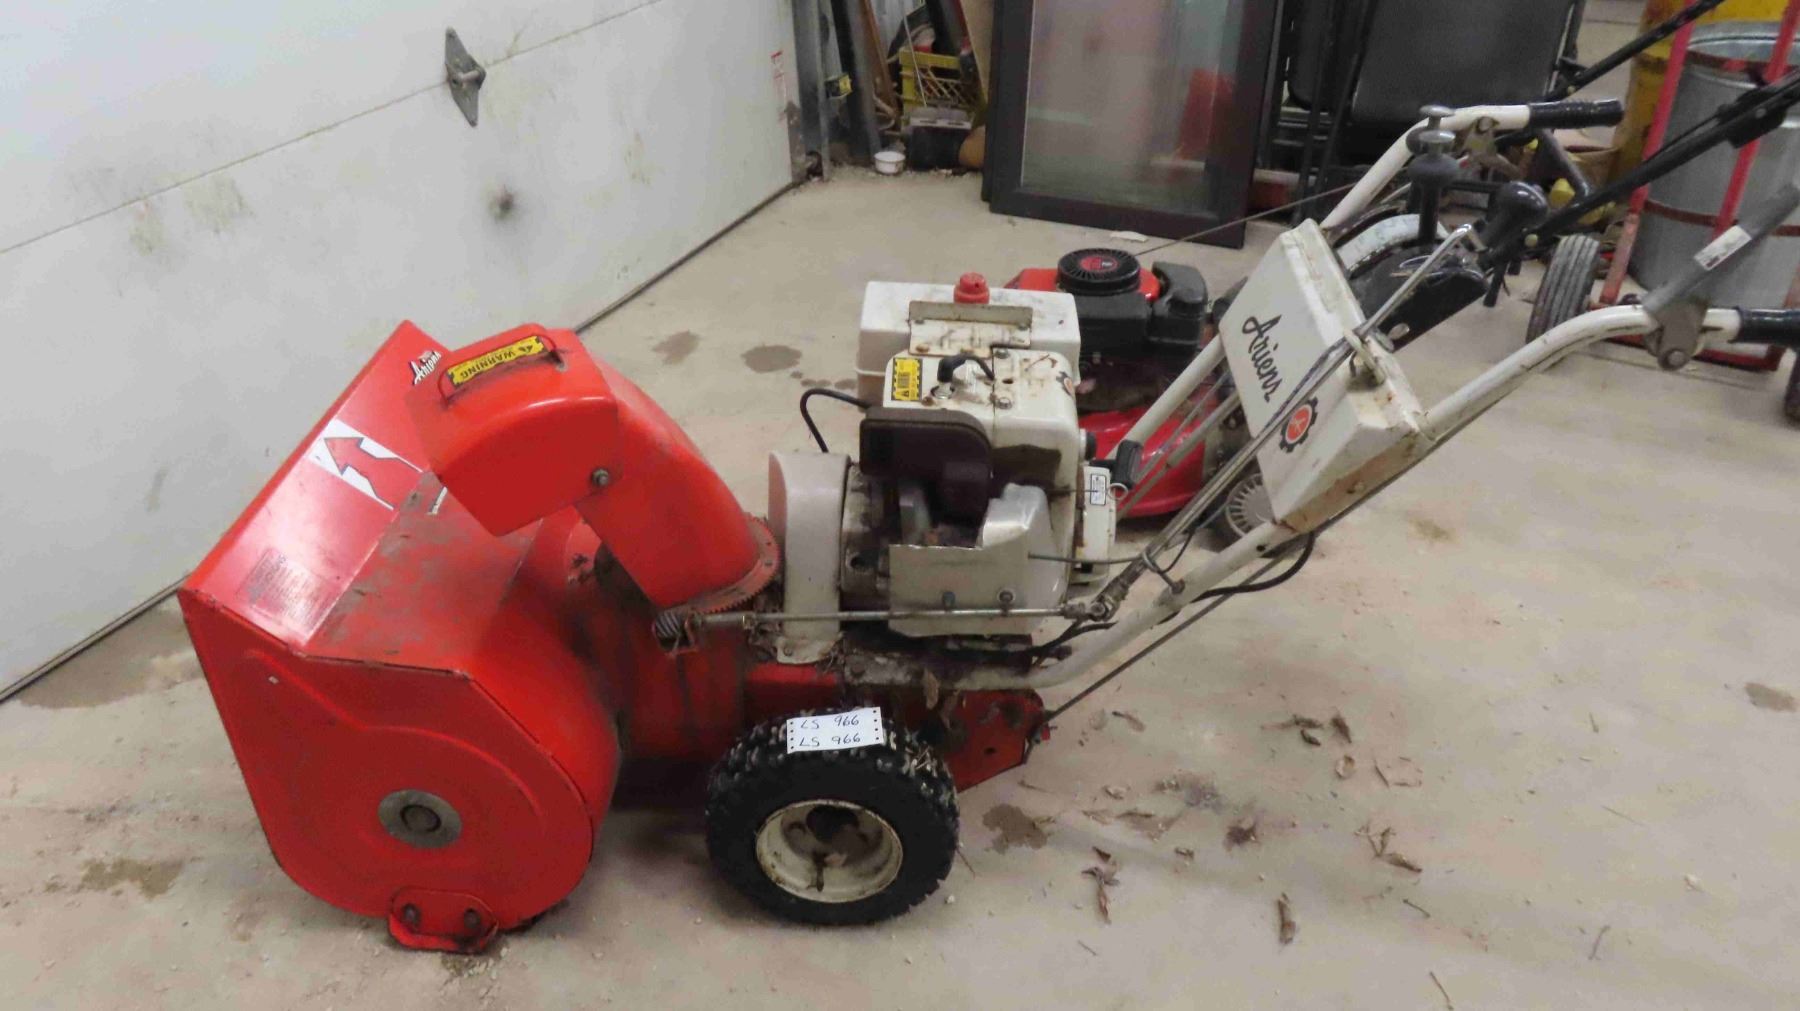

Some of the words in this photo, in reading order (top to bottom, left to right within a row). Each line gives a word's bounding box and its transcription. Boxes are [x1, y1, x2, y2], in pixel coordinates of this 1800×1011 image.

[460, 350, 516, 379] WARNING
[1241, 313, 1283, 403] Ariens
[800, 718, 820, 730] LS
[834, 714, 860, 727] 966
[799, 736, 820, 748] LS
[831, 733, 861, 746] 966
